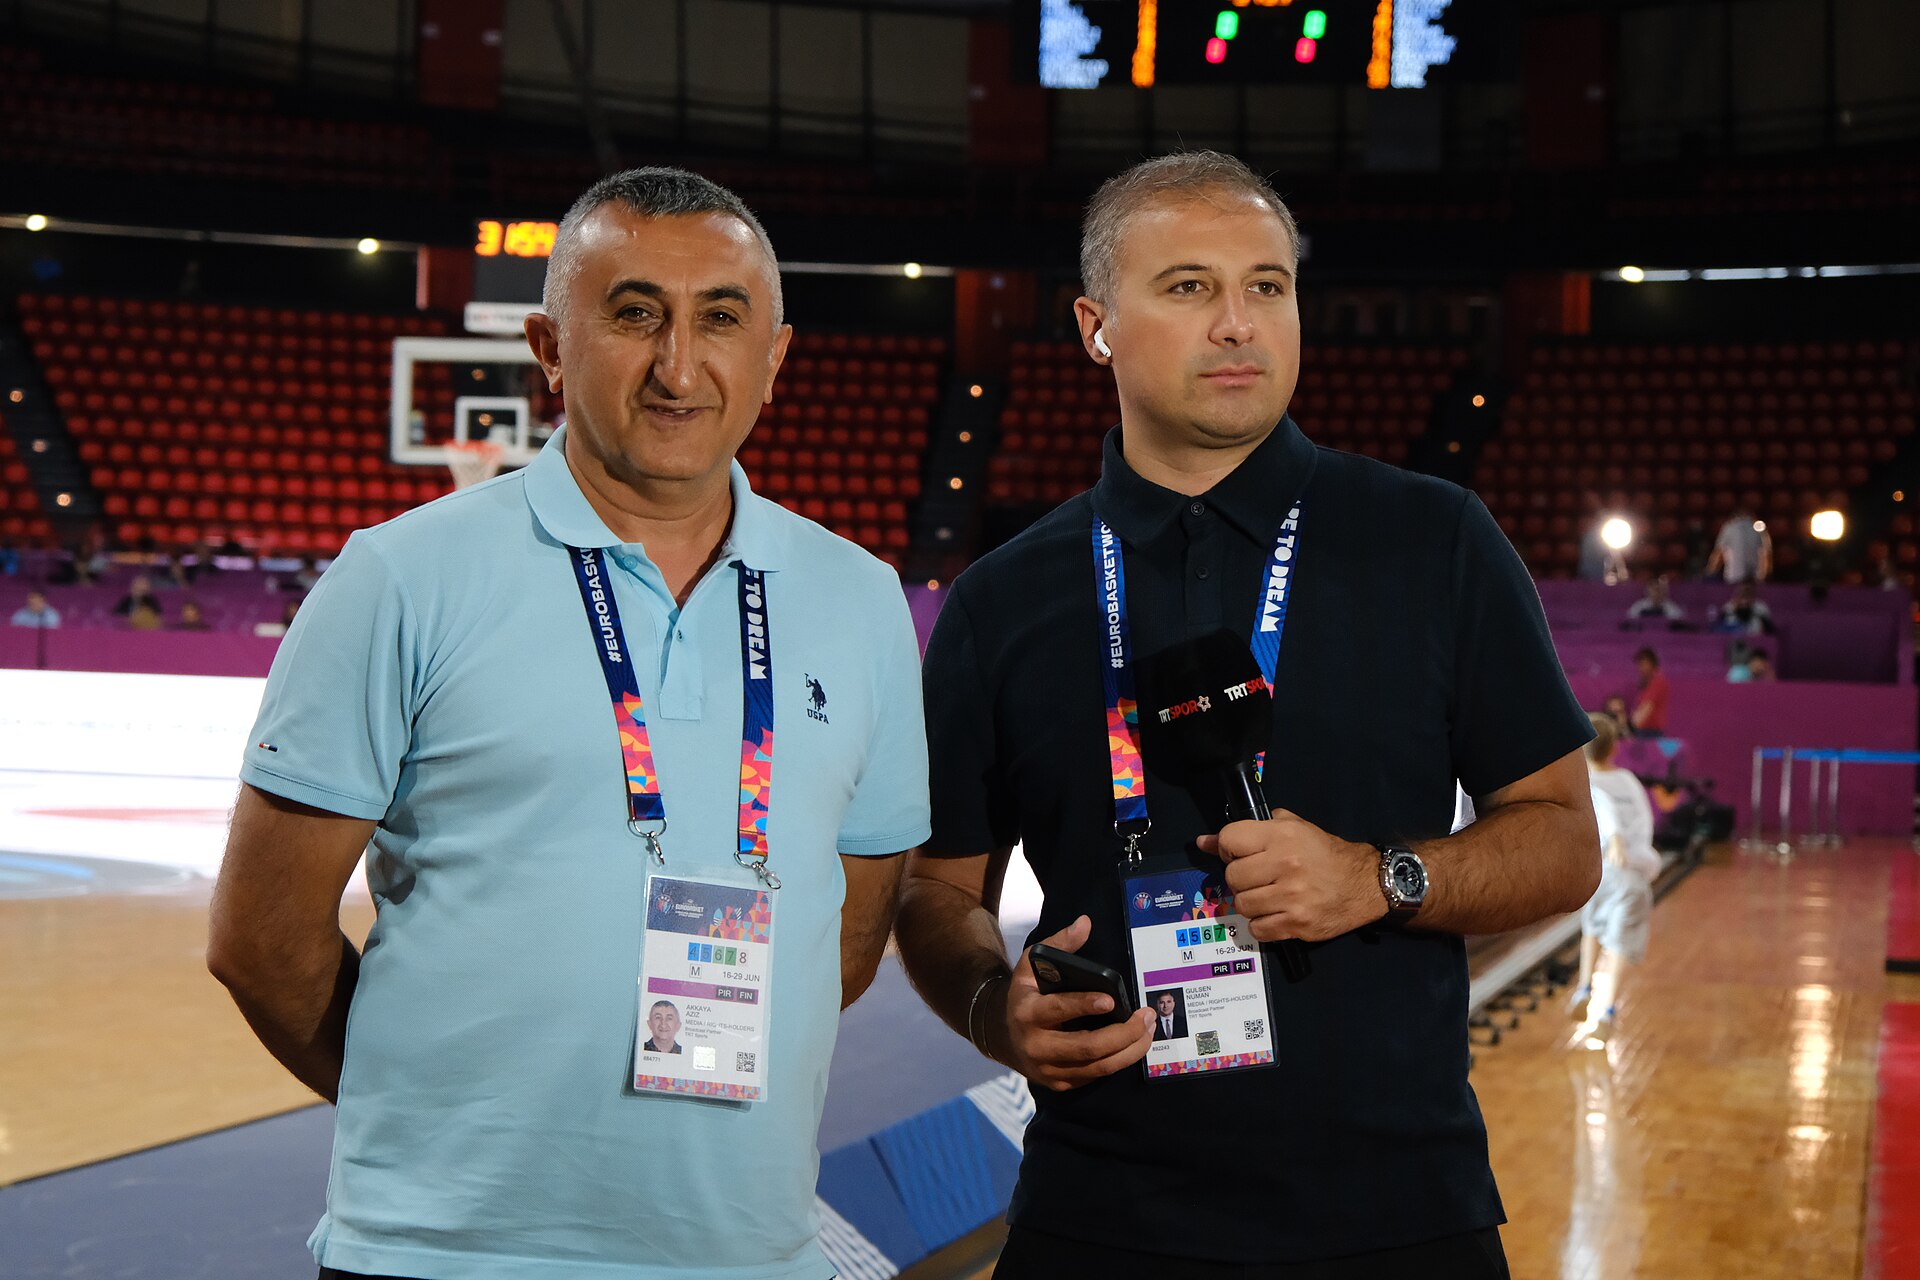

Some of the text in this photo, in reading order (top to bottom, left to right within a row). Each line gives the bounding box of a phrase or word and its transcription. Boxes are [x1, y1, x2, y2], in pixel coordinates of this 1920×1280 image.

[1274, 535, 1295, 562] TO
[745, 583, 762, 609] TO
[1100, 521, 1125, 669] #EUROBASKETWO
[1260, 564, 1290, 633] DREAM
[747, 611, 768, 680] DREAM
[806, 708, 829, 724] USPA
[1183, 950, 1193, 960] M
[1215, 943, 1254, 955] 16-29 JUN
[690, 965, 701, 976] M
[1213, 962, 1250, 974] PIR FIN
[722, 971, 760, 982] 16-29 JUN
[717, 988, 753, 1000] PIR FIN
[1185, 985, 1212, 994] GULSEN
[1186, 992, 1210, 1000] NUMAN
[1187, 1000, 1205, 1008] MEDIA
[1208, 994, 1258, 1005] RIGHTS-HOLDERS
[685, 1004, 712, 1013] AKKAYA
[685, 1010, 700, 1018] AZIZ
